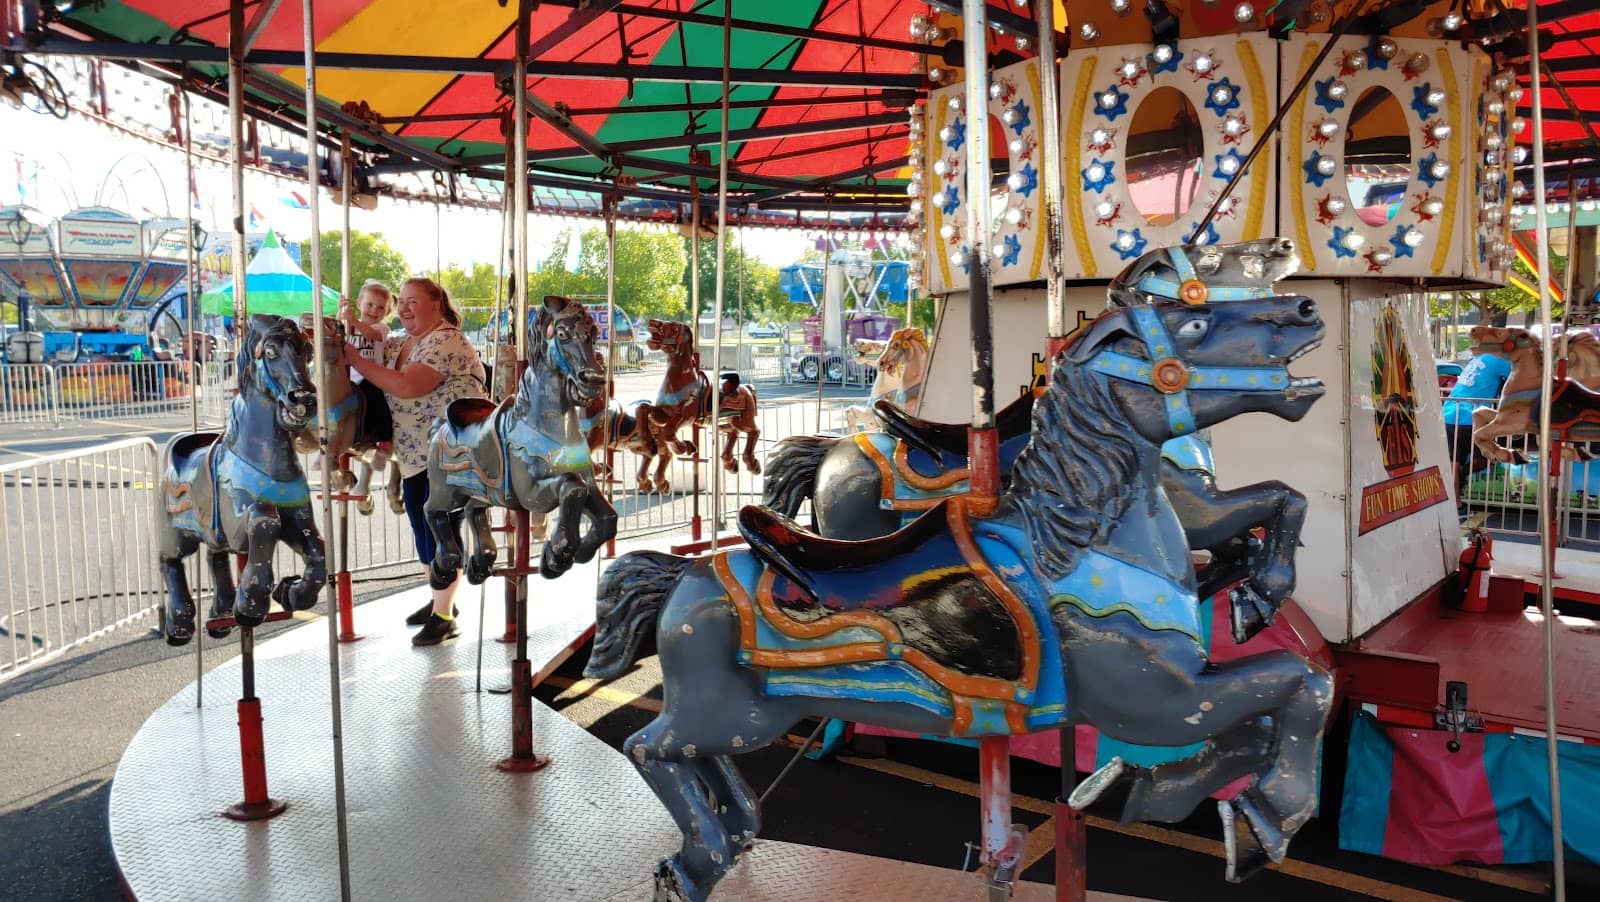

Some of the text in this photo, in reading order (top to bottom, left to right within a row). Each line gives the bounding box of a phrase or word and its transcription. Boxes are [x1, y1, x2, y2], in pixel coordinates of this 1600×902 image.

[1366, 474, 1440, 521] FUN TIME SHOWS
